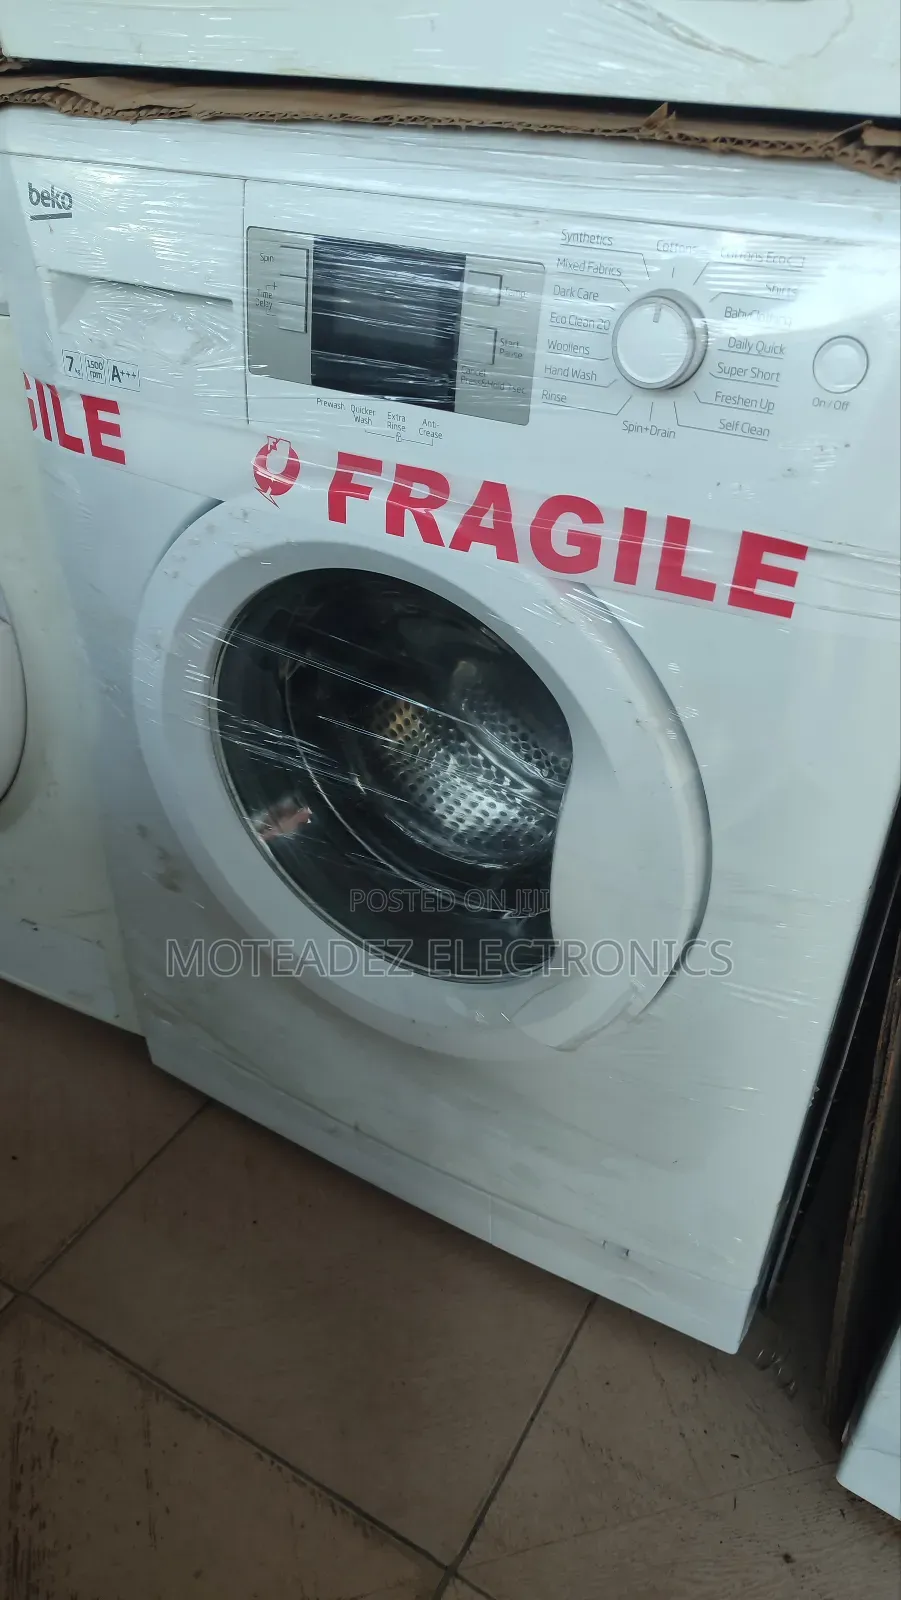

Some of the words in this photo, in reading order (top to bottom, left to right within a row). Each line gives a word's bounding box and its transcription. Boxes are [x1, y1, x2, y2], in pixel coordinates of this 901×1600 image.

[28, 182, 73, 211] beko
[561, 228, 614, 247] Synthetics
[259, 252, 275, 264] Spin
[556, 257, 586, 272] Mixed
[587, 262, 622, 277] Fabrics
[256, 288, 273, 299] Time
[553, 284, 577, 299] Dark
[576, 287, 599, 302] Care
[255, 297, 273, 311] Delay
[549, 311, 568, 325] Eco
[567, 314, 596, 329] Clean
[596, 318, 611, 331] 20
[500, 338, 520, 348] Start
[547, 338, 590, 355] Woollens
[727, 336, 754, 352] Daily
[755, 340, 786, 356] Quick
[65, 355, 74, 372] 7
[86, 359, 104, 371] 1500
[89, 370, 103, 380] rpm
[111, 365, 137, 383] A+++
[544, 364, 570, 377] Hand
[571, 368, 597, 381] Wash
[716, 362, 749, 378] Super
[750, 366, 781, 383] Short
[316, 397, 346, 411] Prewash
[541, 389, 568, 403] Rinse
[714, 390, 759, 409] Freshen
[759, 397, 776, 413] Up
[811, 396, 827, 408] On
[833, 399, 850, 412] Off
[350, 404, 377, 417] Quicker
[387, 411, 407, 423] Extra
[353, 414, 374, 426] Wash
[386, 421, 407, 432] Rinse
[421, 418, 441, 429] Anti-
[717, 418, 742, 433] Self
[740, 421, 771, 437] Clean
[418, 427, 443, 440] Crease
[621, 420, 677, 440] Spin+Drain
[327, 450, 810, 619] FRAGILE
